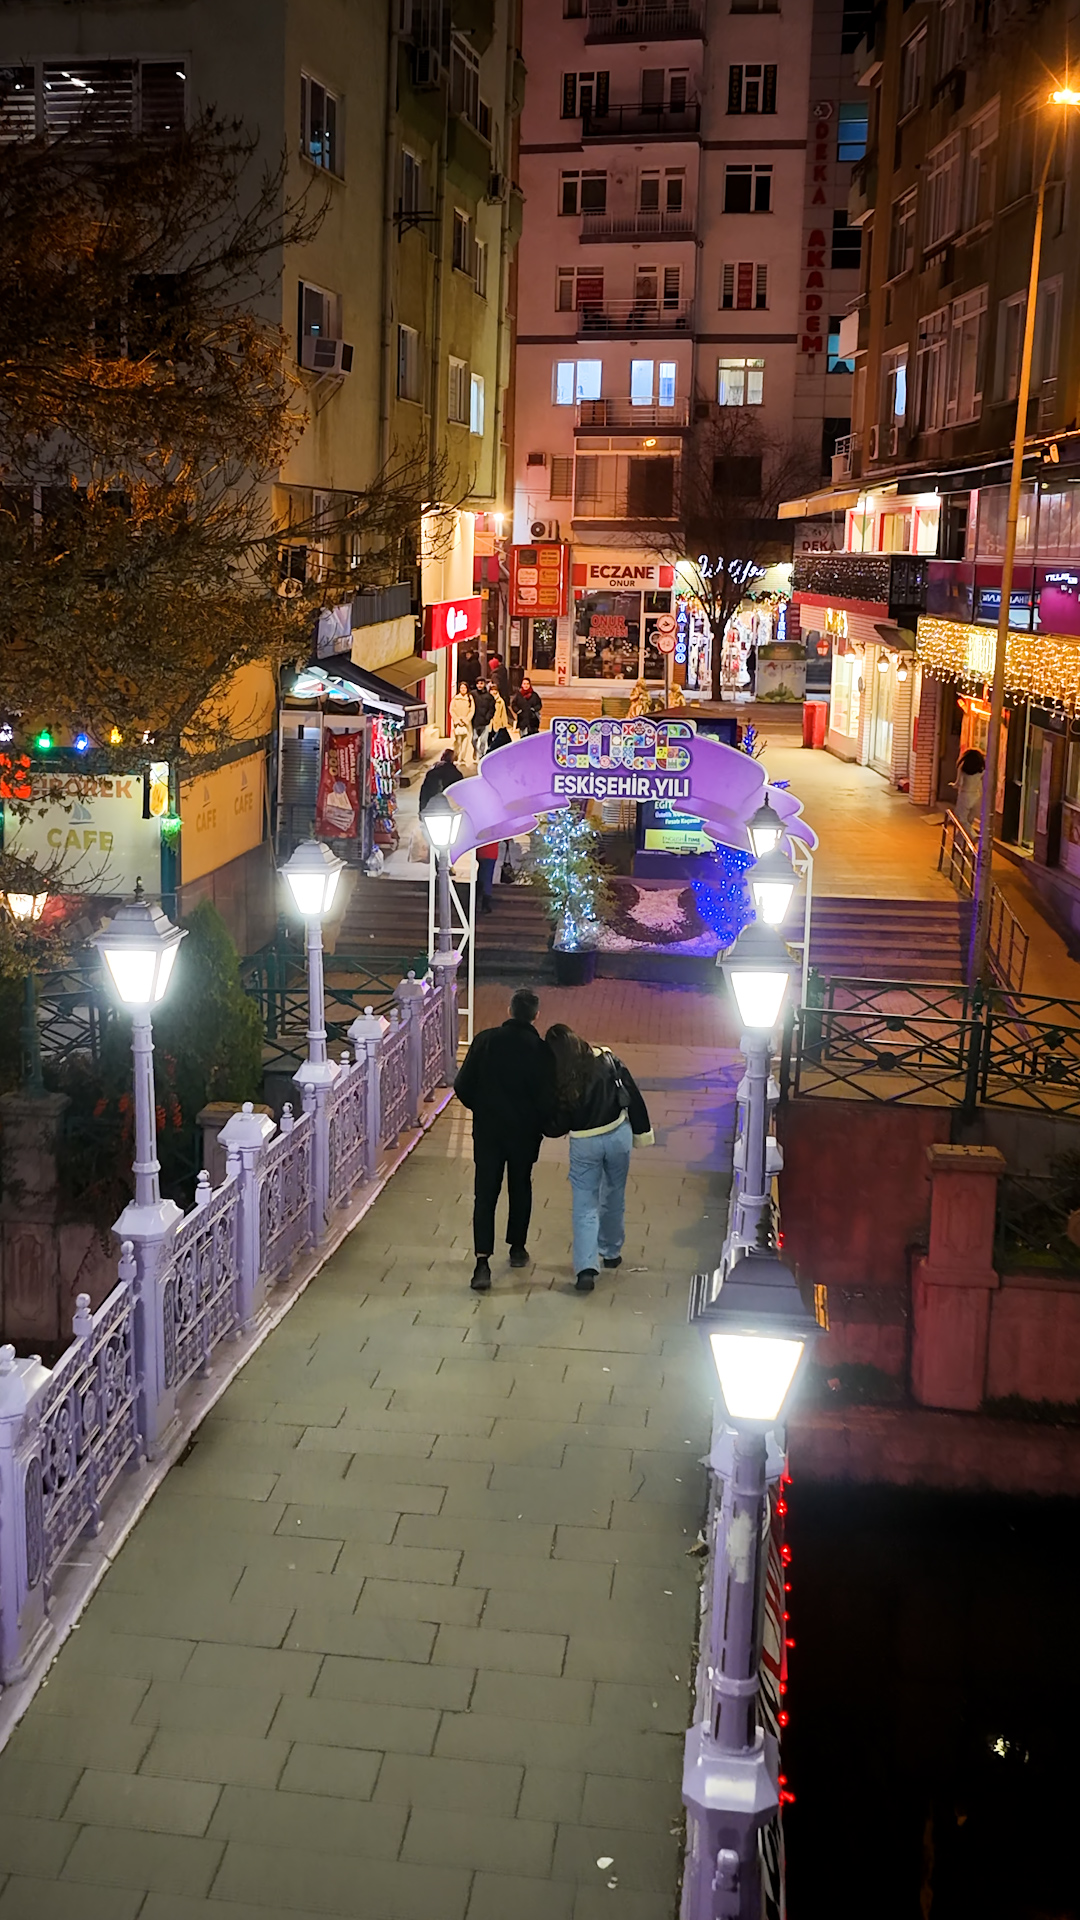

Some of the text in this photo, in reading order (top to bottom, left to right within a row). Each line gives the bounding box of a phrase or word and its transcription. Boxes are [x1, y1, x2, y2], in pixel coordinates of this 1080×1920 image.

[812, 121, 829, 205] DEKA
[802, 541, 837, 551] DEKA
[590, 565, 655, 579] ECZANE
[591, 615, 626, 627] ONUR
[675, 602, 688, 663] TATTOO
[777, 603, 787, 640] PIER
[553, 772, 690, 798] ESKİŞEHİR YILI
[233, 791, 254, 816] CAFE
[196, 808, 217, 833] CAFE
[47, 828, 114, 851] CAFE
